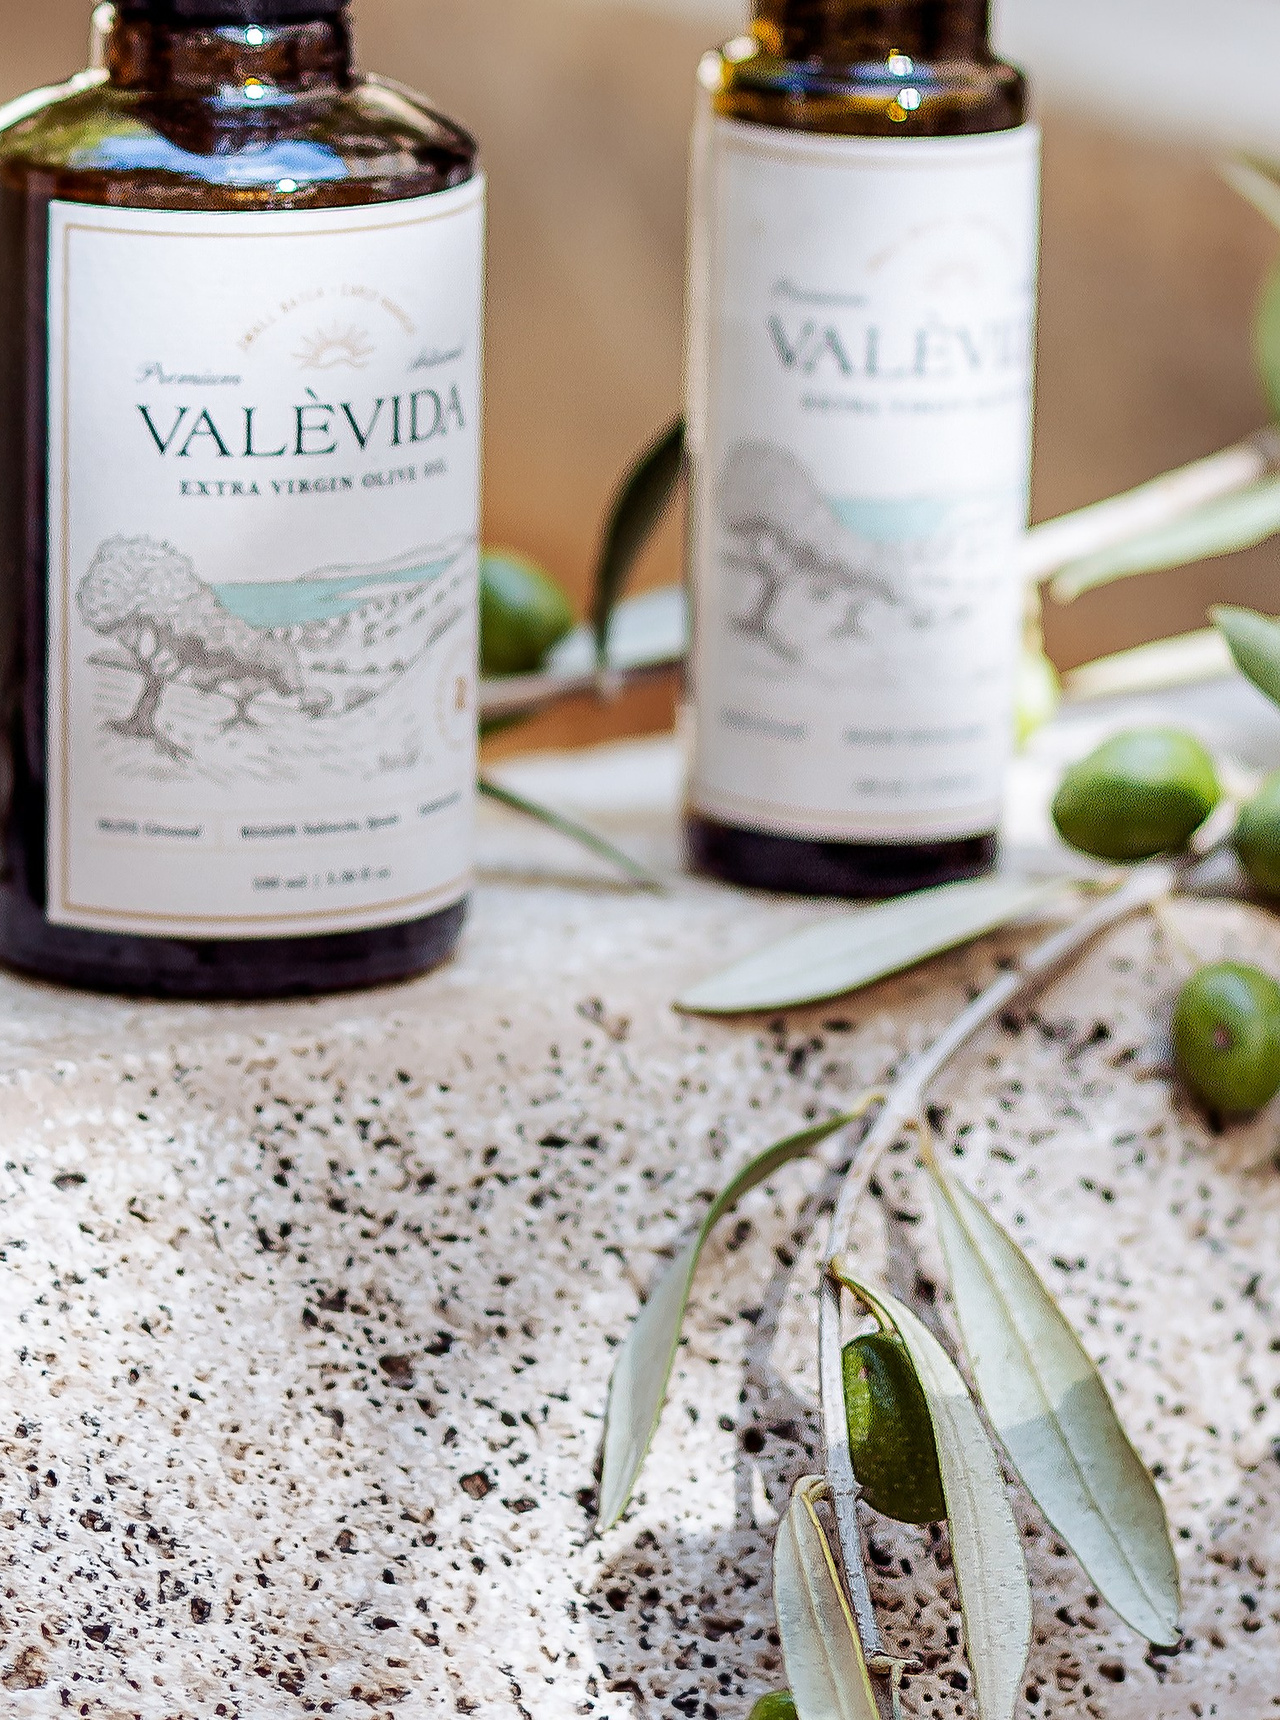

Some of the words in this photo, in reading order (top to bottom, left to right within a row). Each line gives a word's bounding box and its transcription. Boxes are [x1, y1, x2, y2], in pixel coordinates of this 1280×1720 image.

[135, 383, 467, 458] VALÈVIDA
[179, 479, 261, 497] EXTRA
[271, 476, 353, 495] VIRGIN
